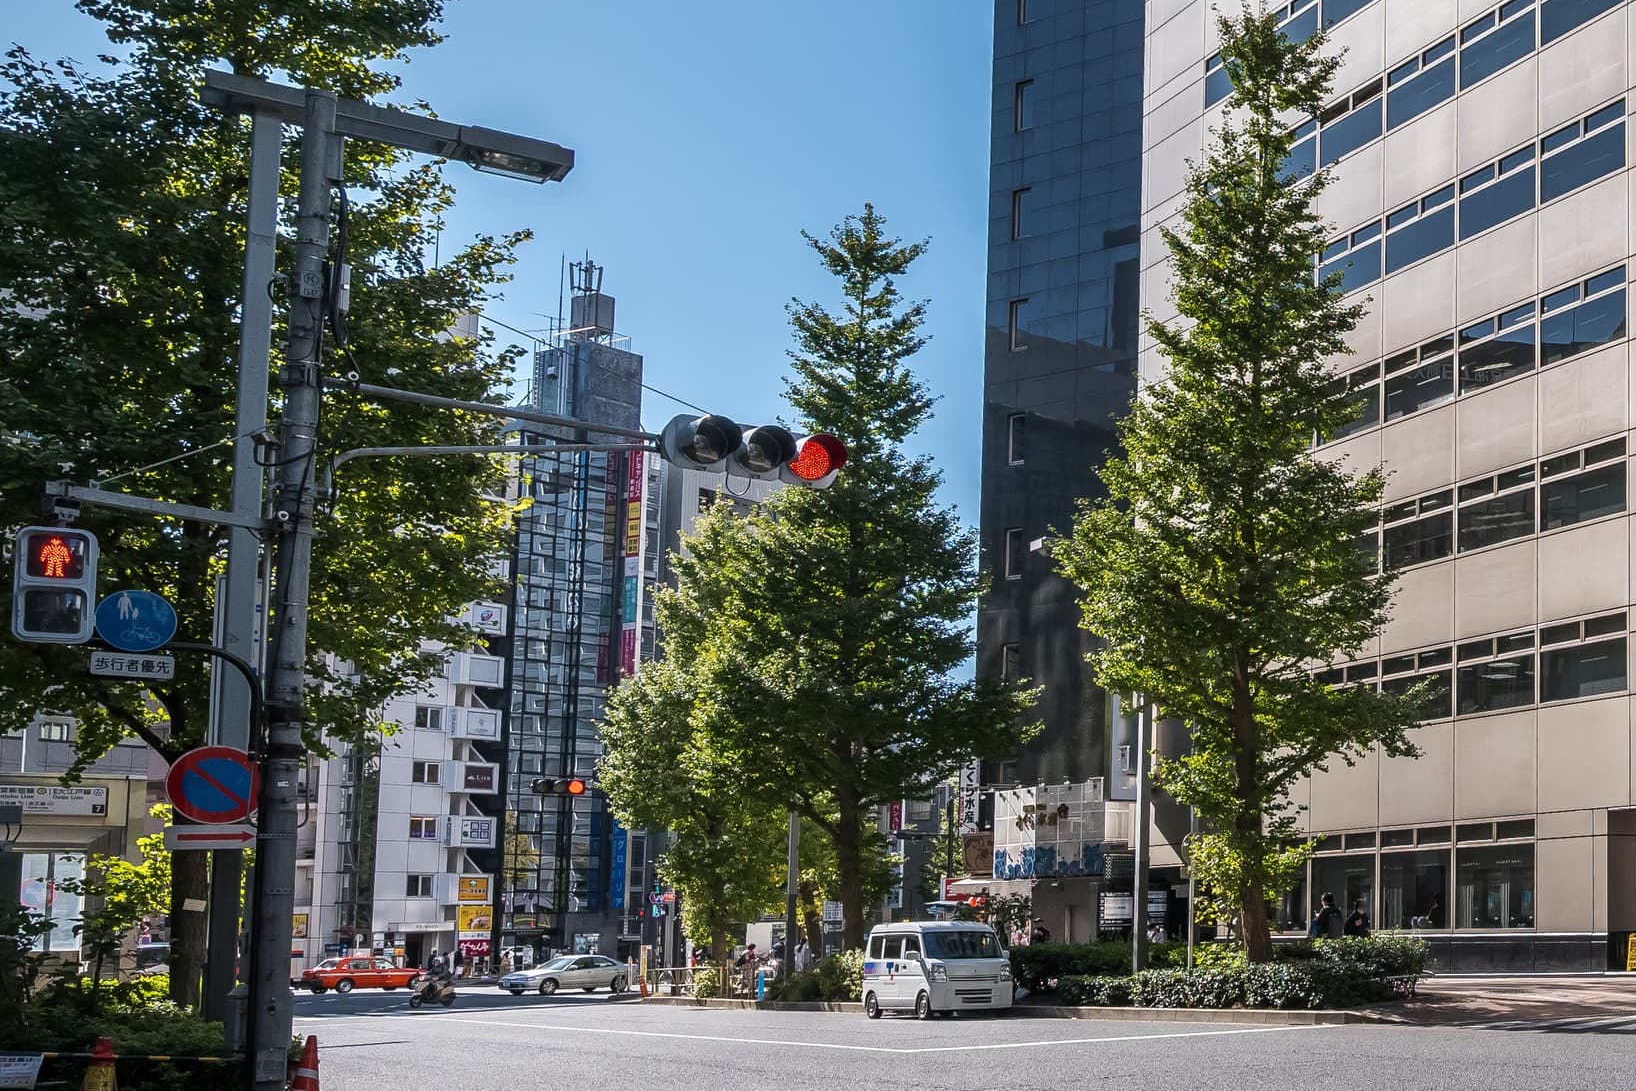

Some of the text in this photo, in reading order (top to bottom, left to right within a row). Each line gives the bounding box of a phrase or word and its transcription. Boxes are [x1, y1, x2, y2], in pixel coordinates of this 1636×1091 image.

[95, 657, 170, 674] 歩行者優先
